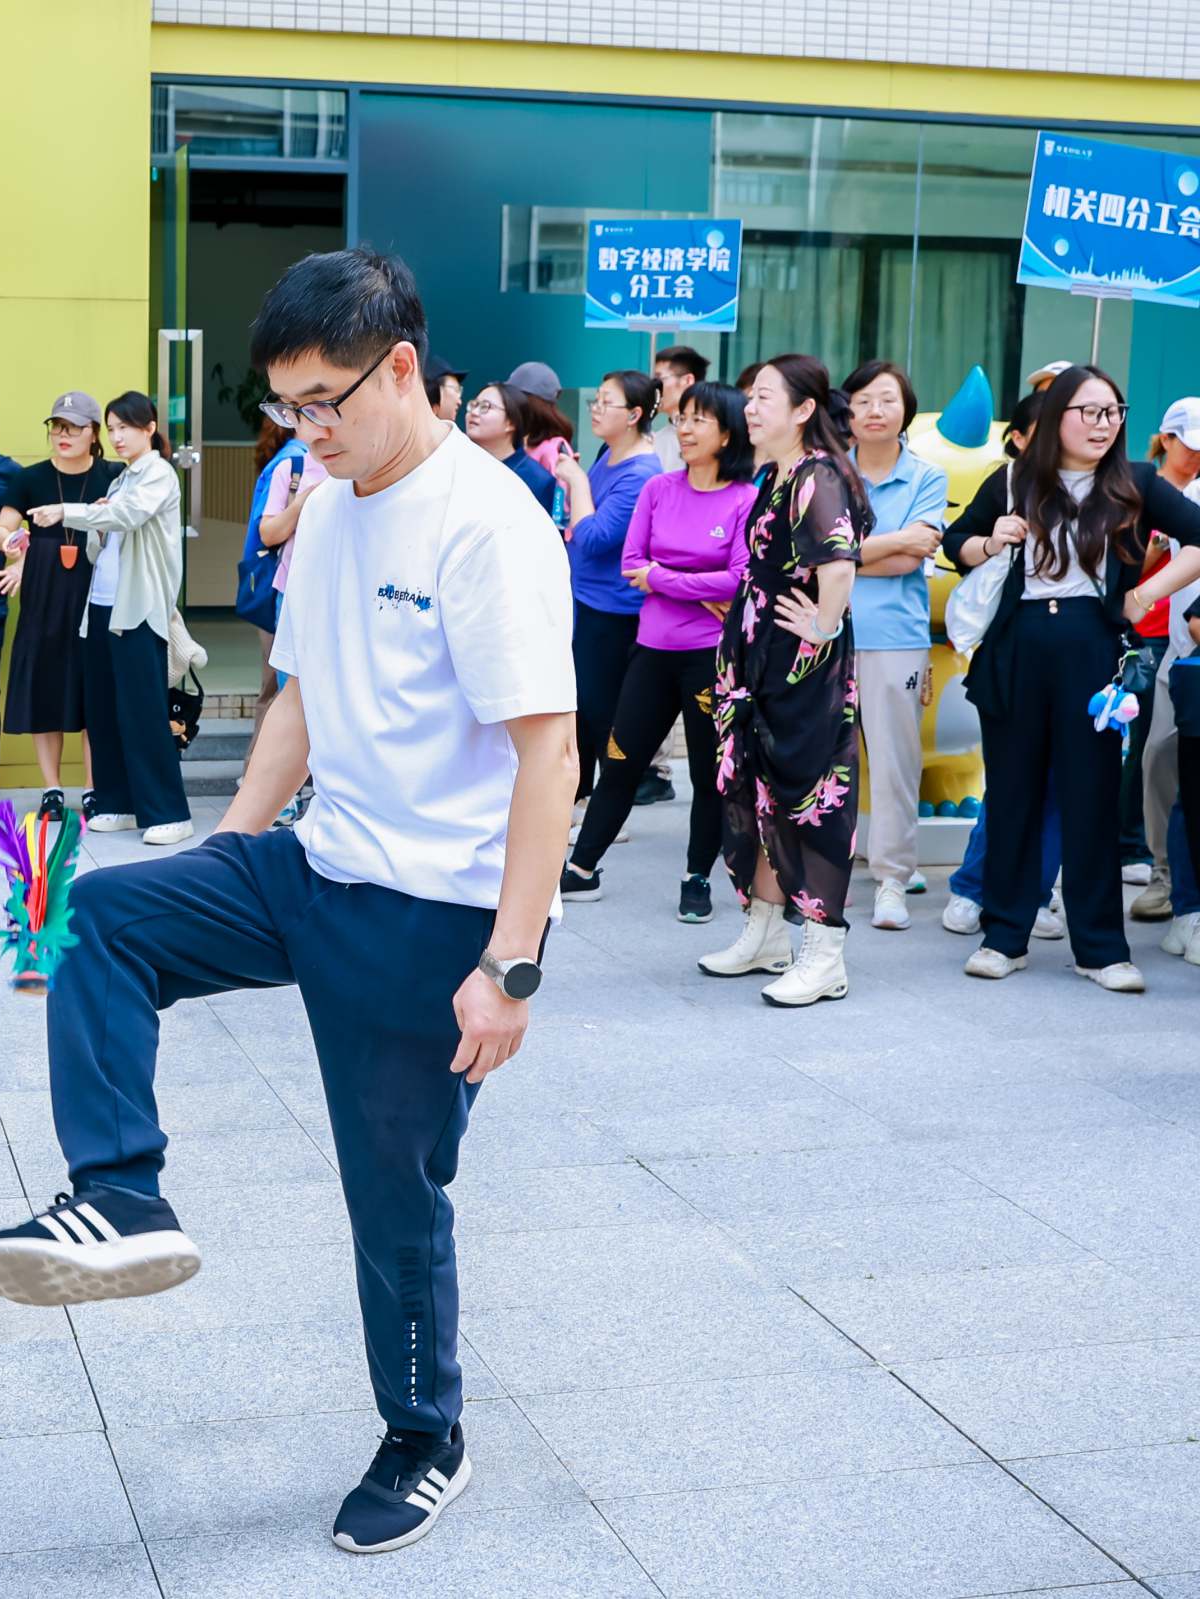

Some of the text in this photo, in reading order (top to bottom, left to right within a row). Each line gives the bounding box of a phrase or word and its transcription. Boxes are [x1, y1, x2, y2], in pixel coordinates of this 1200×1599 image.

[1042, 184, 1200, 239] 机关四分工会
[598, 247, 731, 272] 数字经济学院
[629, 274, 695, 299] 分工会
